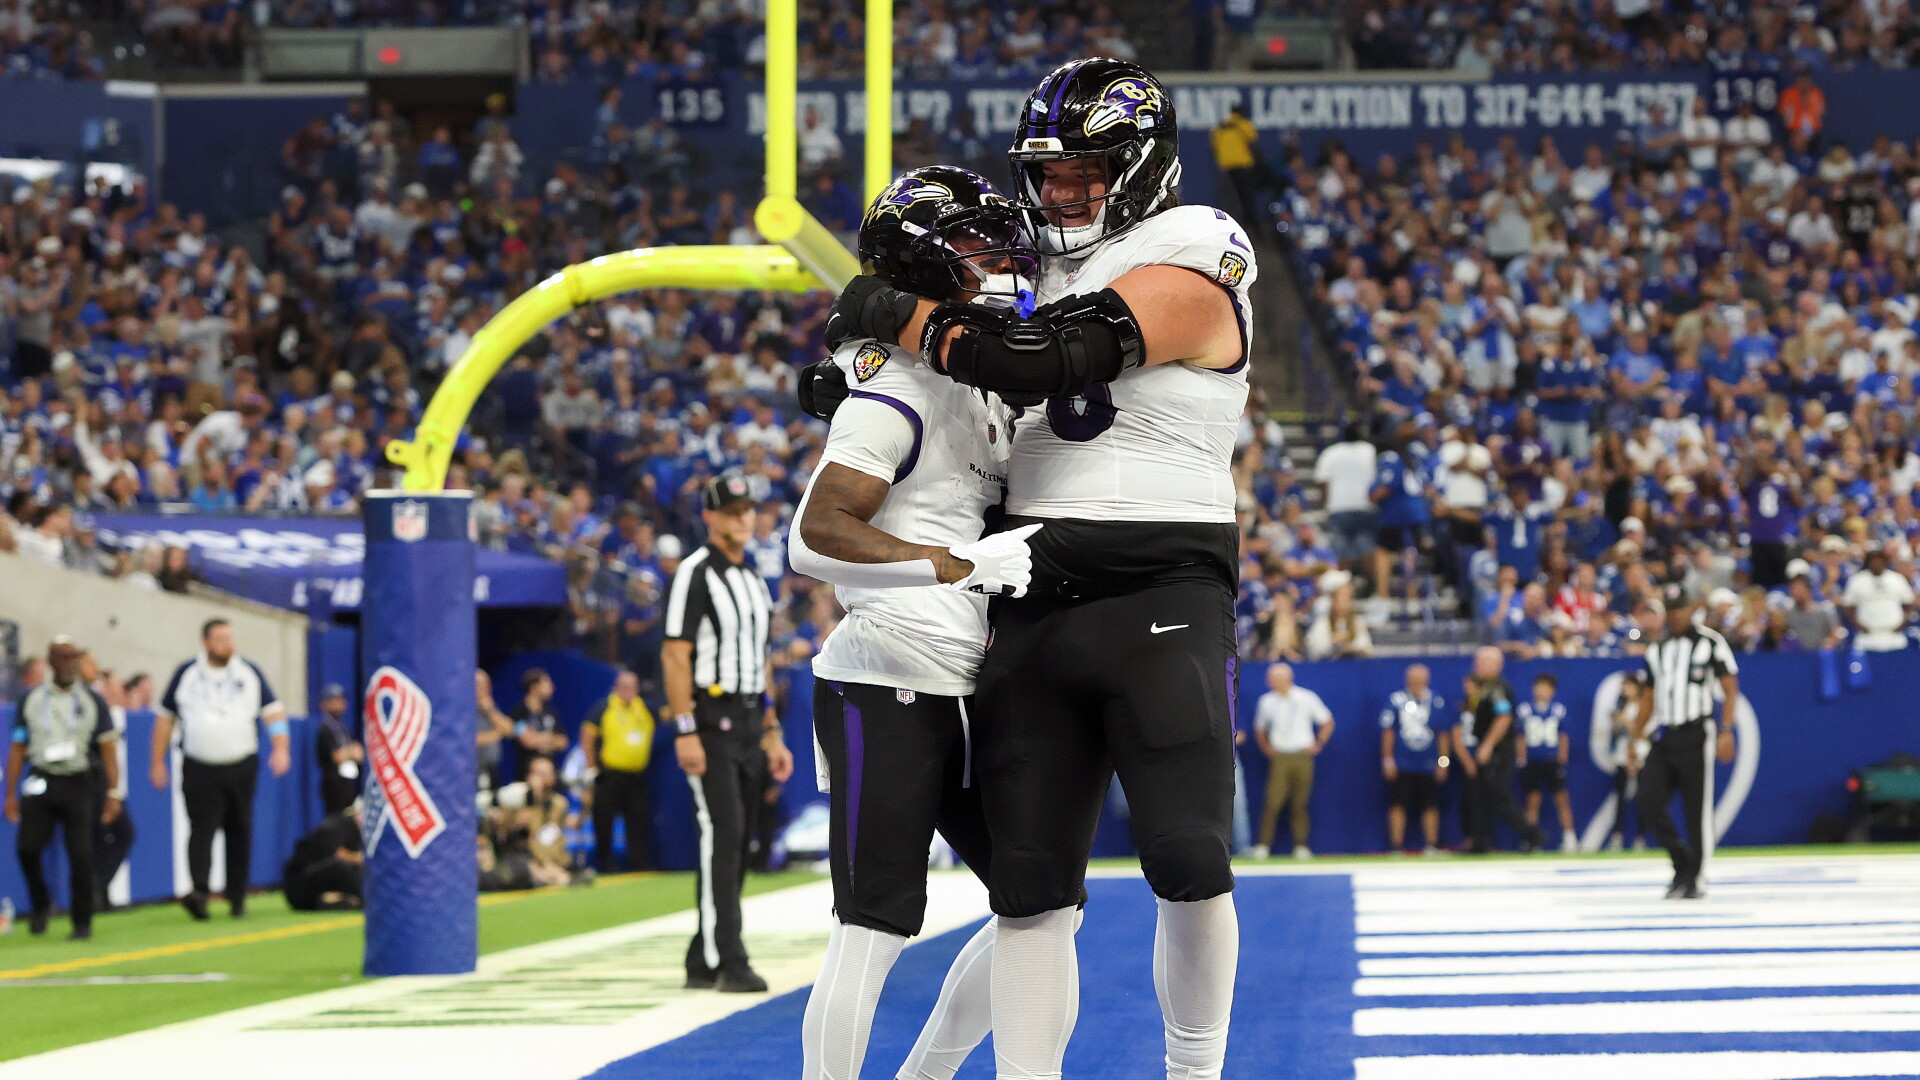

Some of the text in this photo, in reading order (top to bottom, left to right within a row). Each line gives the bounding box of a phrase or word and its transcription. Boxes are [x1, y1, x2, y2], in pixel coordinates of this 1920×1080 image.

[659, 88, 724, 122] 135
[1252, 86, 1411, 129] LOCATION
[1419, 86, 1467, 128] TO
[968, 462, 1008, 486] BALTIMO
